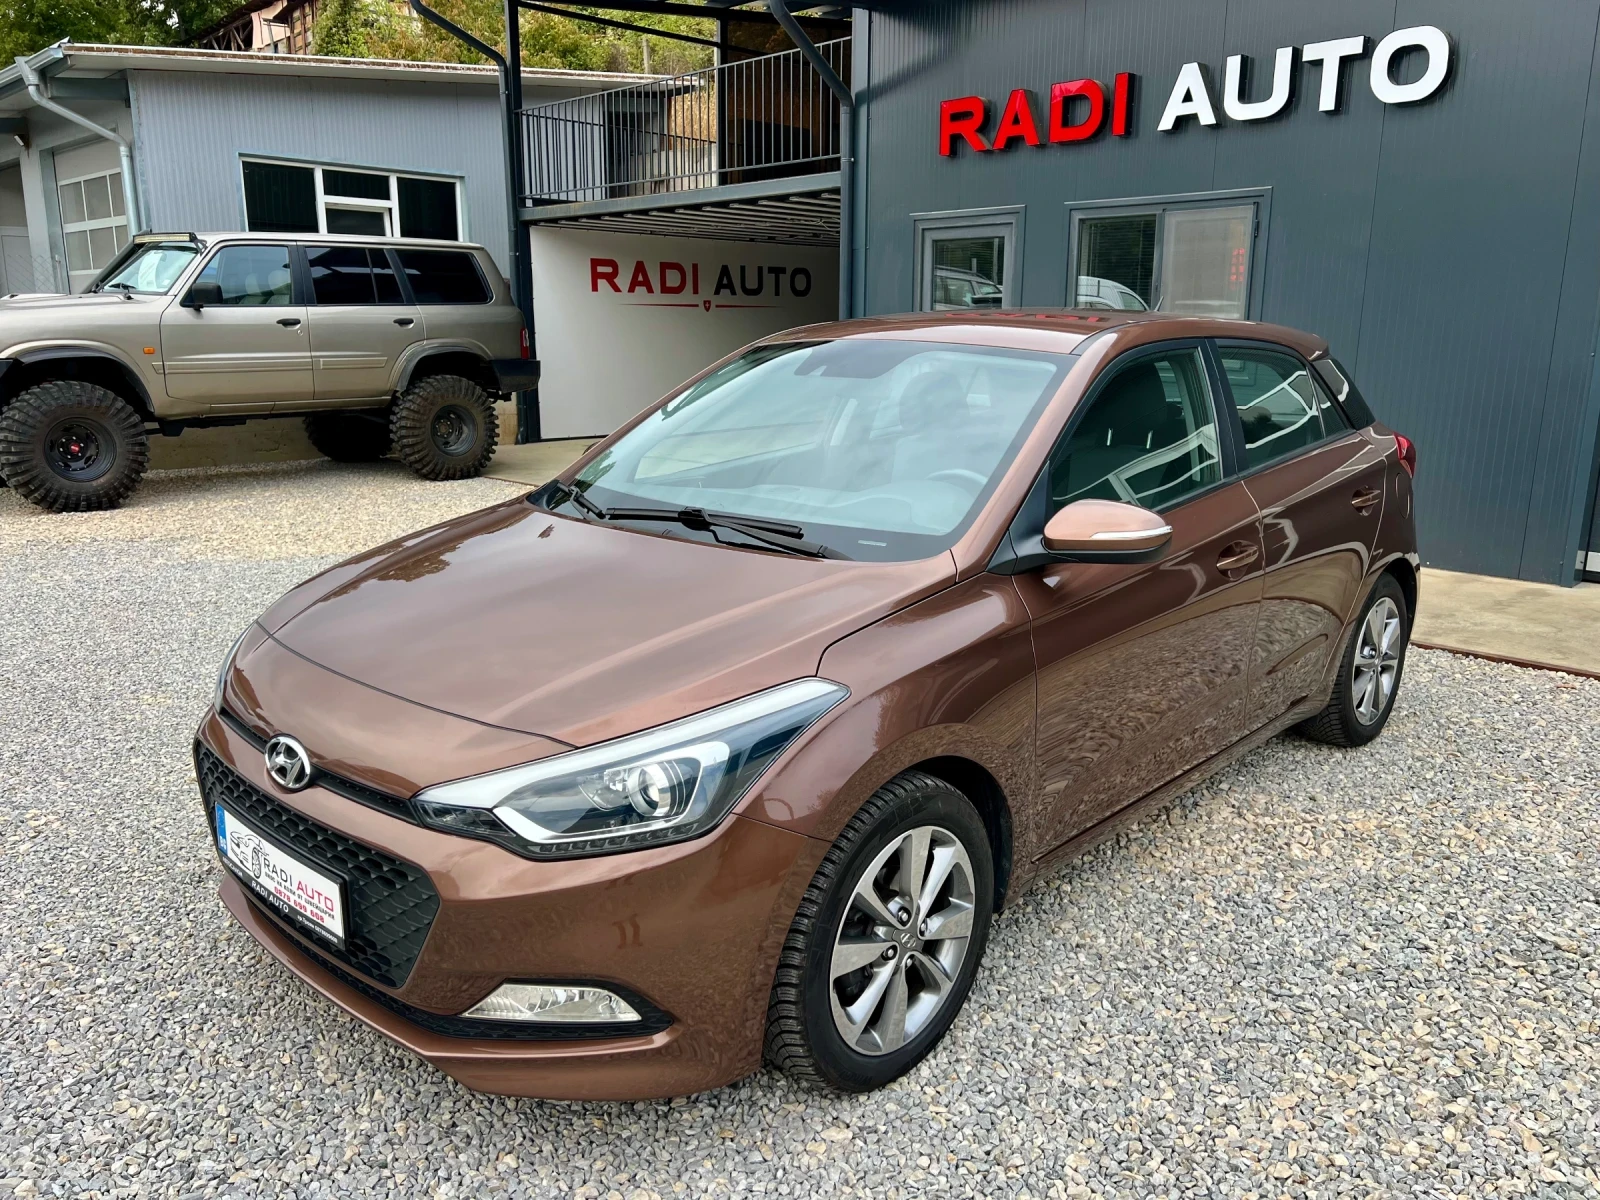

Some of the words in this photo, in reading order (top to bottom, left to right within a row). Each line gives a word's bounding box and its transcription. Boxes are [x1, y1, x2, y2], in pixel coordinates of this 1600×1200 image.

[940, 71, 1136, 157] RADI
[1157, 25, 1453, 131] AUTO
[589, 258, 699, 295] RADI
[713, 264, 812, 297] AUTO
[251, 880, 268, 897] RADI
[269, 895, 289, 912] AUTO
[263, 857, 293, 887] RADI
[296, 880, 334, 912] AUTO
